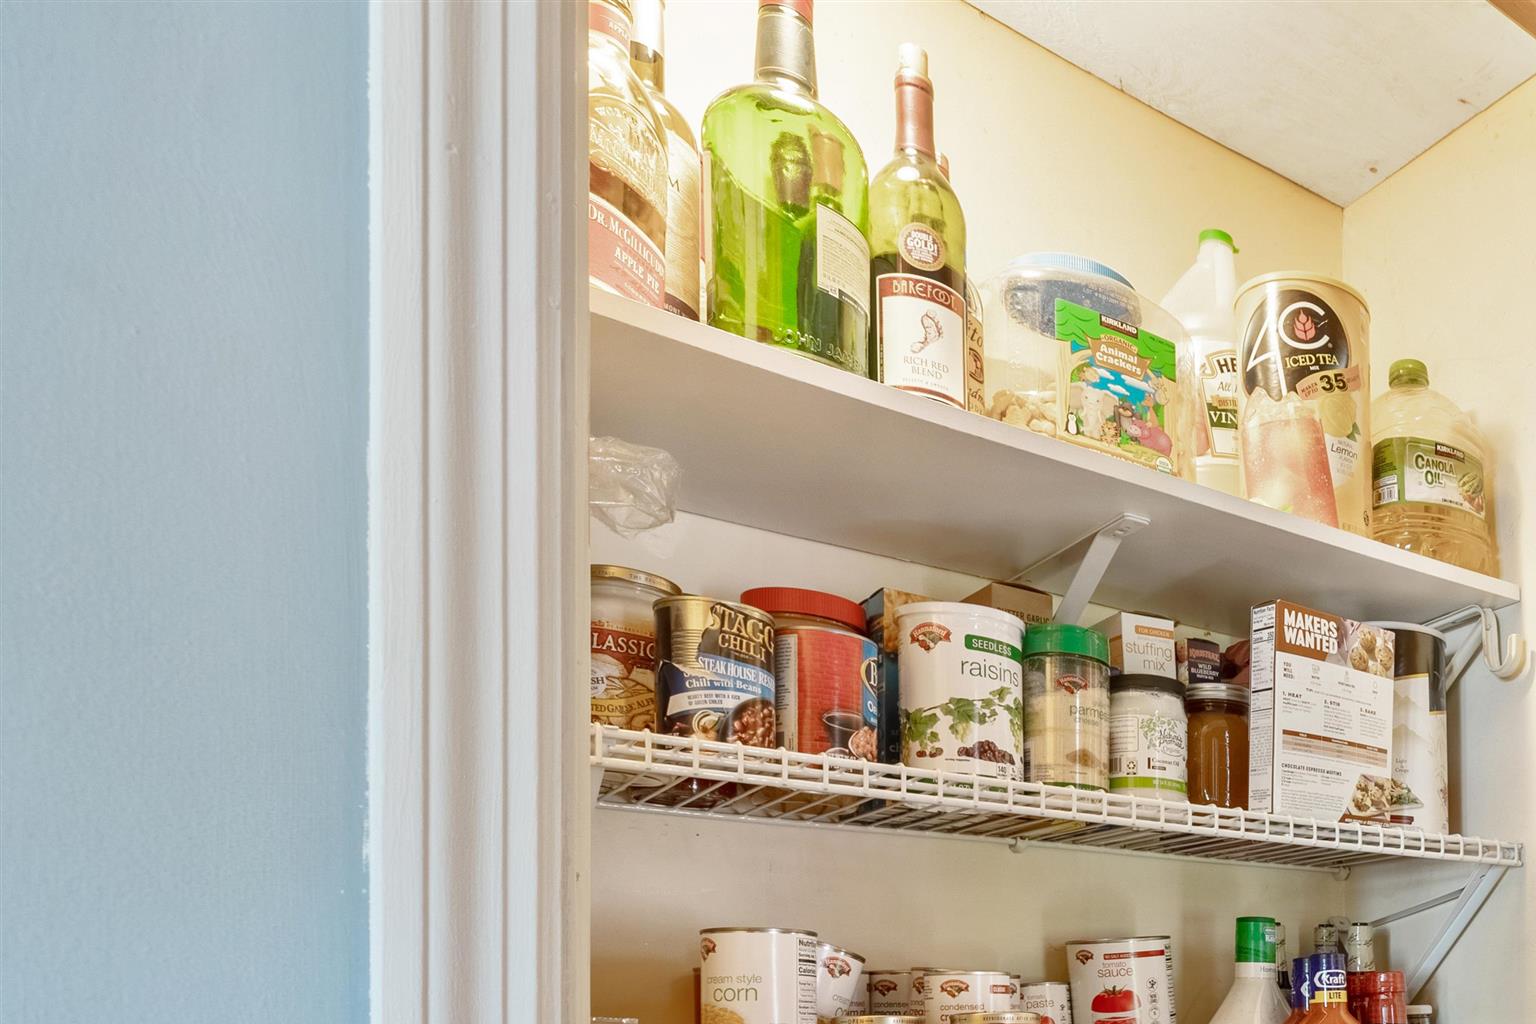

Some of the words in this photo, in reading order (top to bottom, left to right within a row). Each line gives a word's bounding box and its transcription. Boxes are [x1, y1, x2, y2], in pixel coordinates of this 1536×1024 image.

[906, 237, 938, 254] GOLD!
[614, 246, 644, 279] APPLE
[647, 272, 660, 294] PIE
[892, 279, 958, 311] BAREFOOT
[1101, 314, 1138, 335] KIRKLAND
[1103, 334, 1137, 351] ORGANIC
[1100, 343, 1138, 363] Animal
[1285, 354, 1316, 368] ICED
[1318, 353, 1340, 366] TEA
[903, 355, 928, 368] RICH
[931, 359, 950, 373] RED
[1095, 351, 1142, 375] Crackers
[911, 365, 943, 381] BLEND
[1319, 372, 1348, 394] 35
[1330, 443, 1358, 460] Lemon
[1436, 443, 1464, 458] KIRKLAND
[1414, 453, 1455, 476] CANOLA
[1424, 470, 1443, 485] OIL
[912, 623, 948, 638] Hannaford
[1284, 607, 1338, 638] MAKERS
[718, 633, 767, 662] CHILI
[972, 638, 1012, 657] SEEDLESS
[1283, 626, 1338, 655] WANTED
[1125, 641, 1172, 662] stuffing
[698, 656, 727, 675] STEAK
[727, 664, 757, 681] HOUSE
[961, 658, 1019, 688] raisins
[1143, 658, 1167, 672] mix
[1190, 667, 1220, 677] BLUEBERRY
[685, 678, 712, 690] Chili
[712, 678, 734, 689] with
[735, 680, 762, 695] Beans
[706, 975, 734, 985] cream
[736, 973, 763, 986] style
[1097, 967, 1134, 978] sauce
[1321, 973, 1345, 985] Kraft
[712, 986, 758, 1002] corn
[1328, 991, 1342, 1000] LITE
[940, 1003, 985, 1011] condensed
[1026, 1000, 1055, 1010] paste
